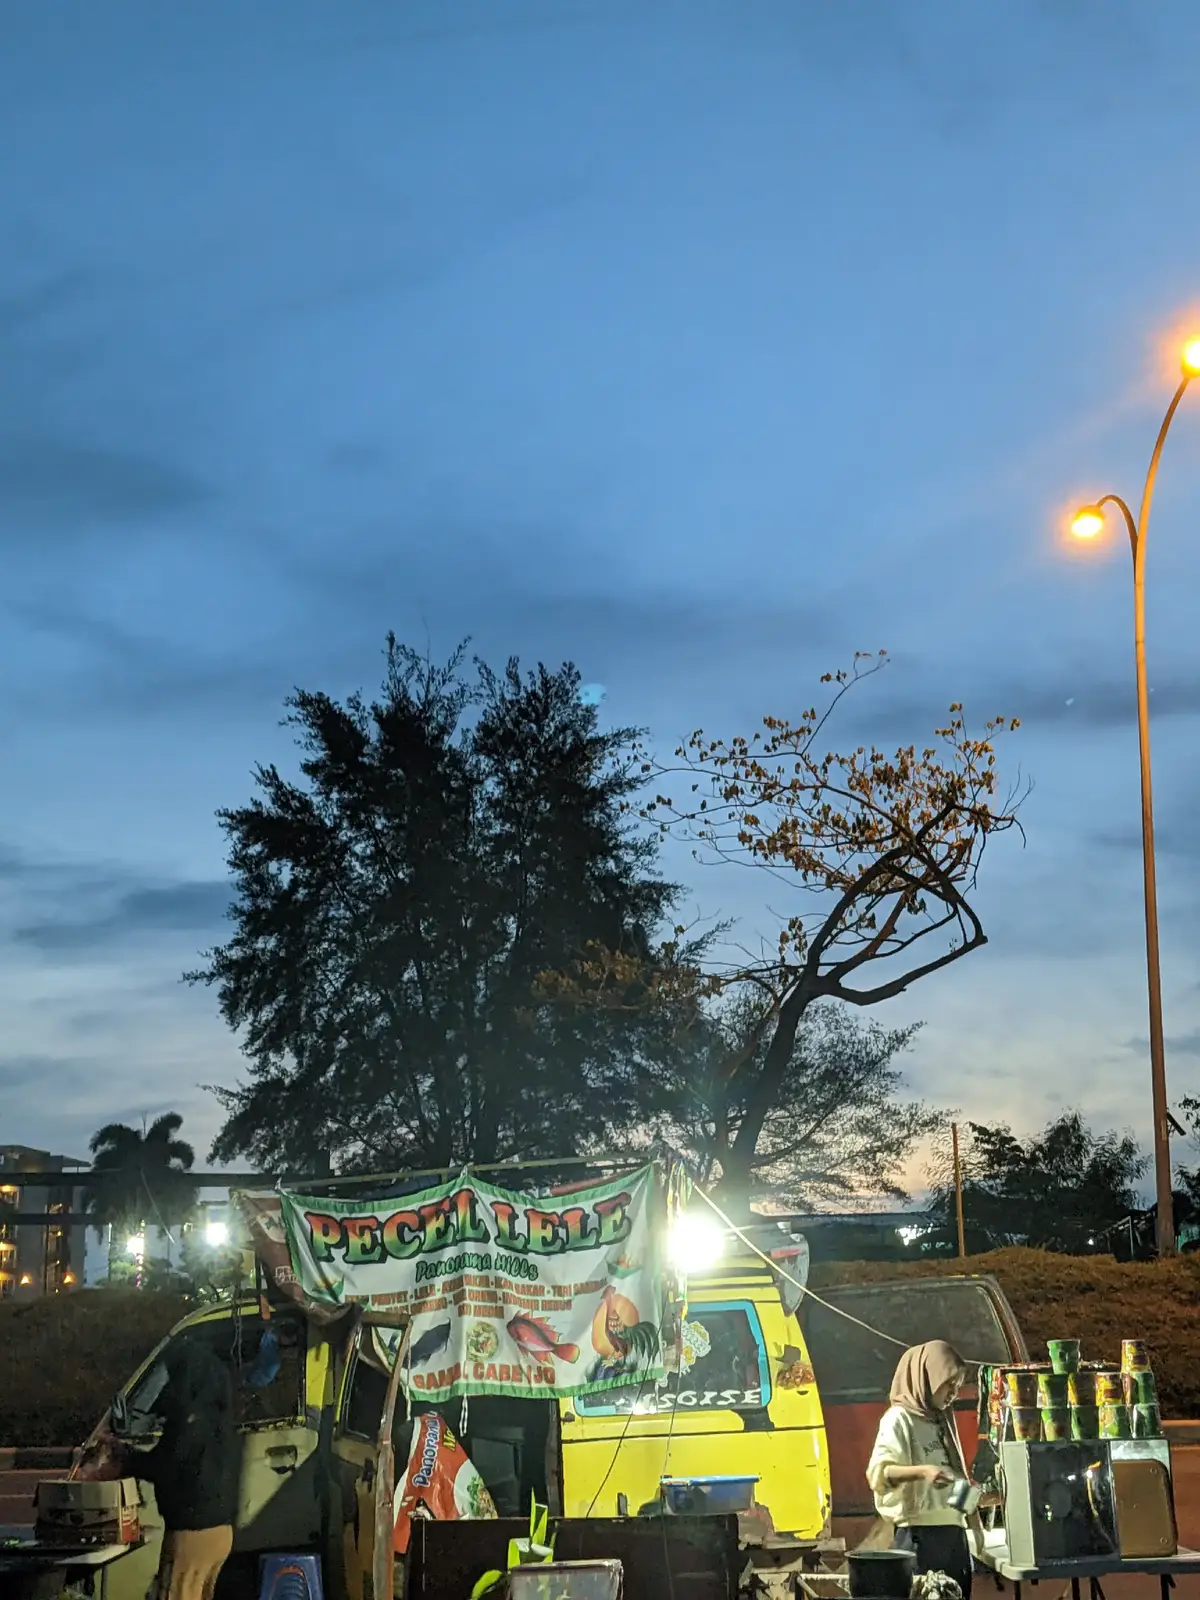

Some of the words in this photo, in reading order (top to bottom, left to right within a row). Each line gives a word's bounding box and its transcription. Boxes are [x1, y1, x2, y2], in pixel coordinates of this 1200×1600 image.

[304, 1188, 489, 1264] PECEL
[490, 1191, 633, 1257] LELE
[415, 1252, 492, 1282] Panorama
[494, 1253, 540, 1281] Hills
[413, 1361, 469, 1391] SAMBL
[472, 1361, 523, 1383] CABE
